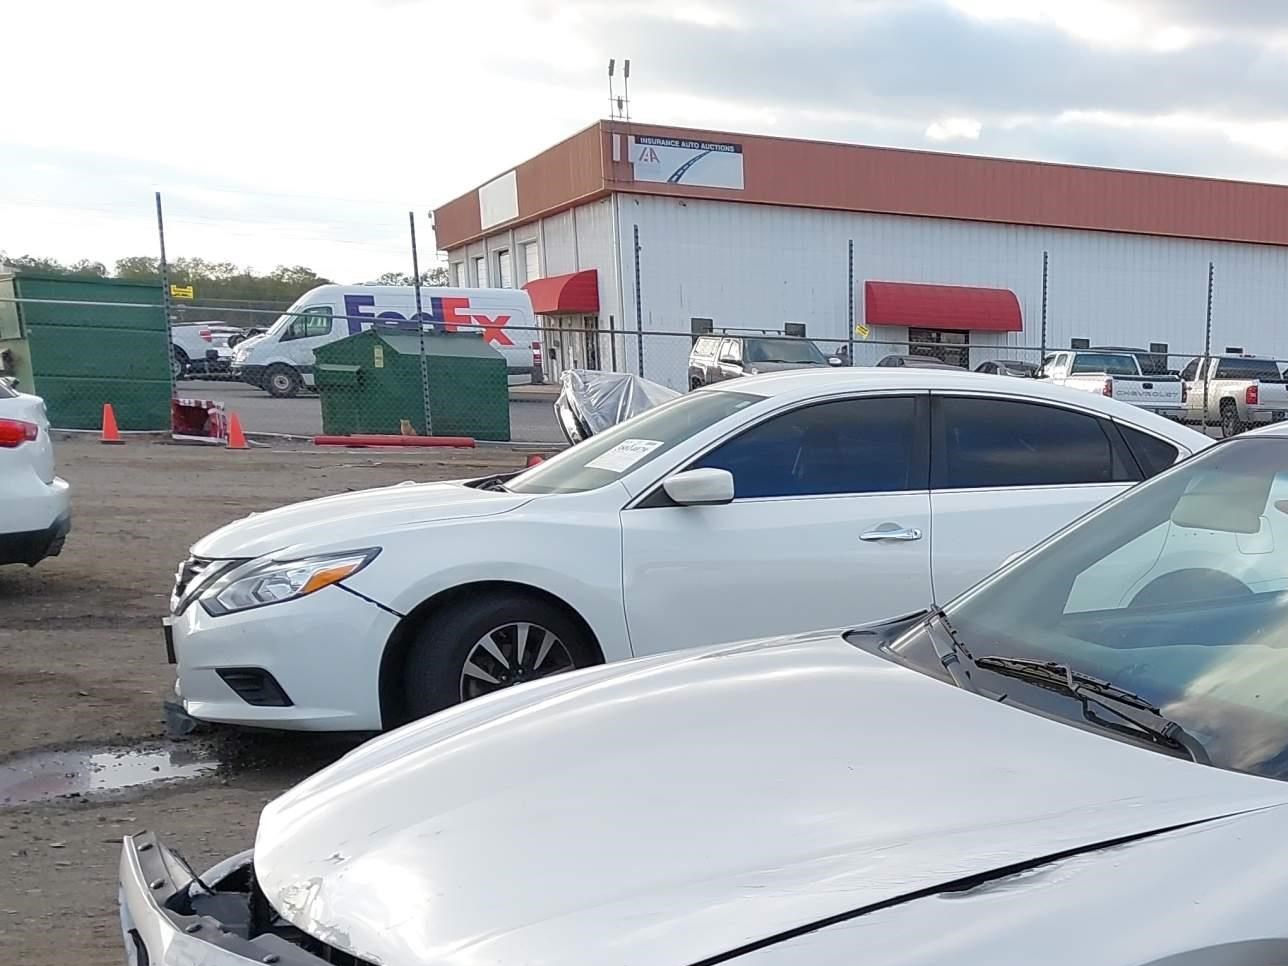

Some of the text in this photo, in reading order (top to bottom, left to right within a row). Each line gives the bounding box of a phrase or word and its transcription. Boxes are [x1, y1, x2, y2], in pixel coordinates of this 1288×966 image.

[639, 136, 735, 152] INSURANCE AUTO AUCTIONS
[344, 294, 515, 346] FedEx
[1115, 388, 1179, 398] CHEVROLET
